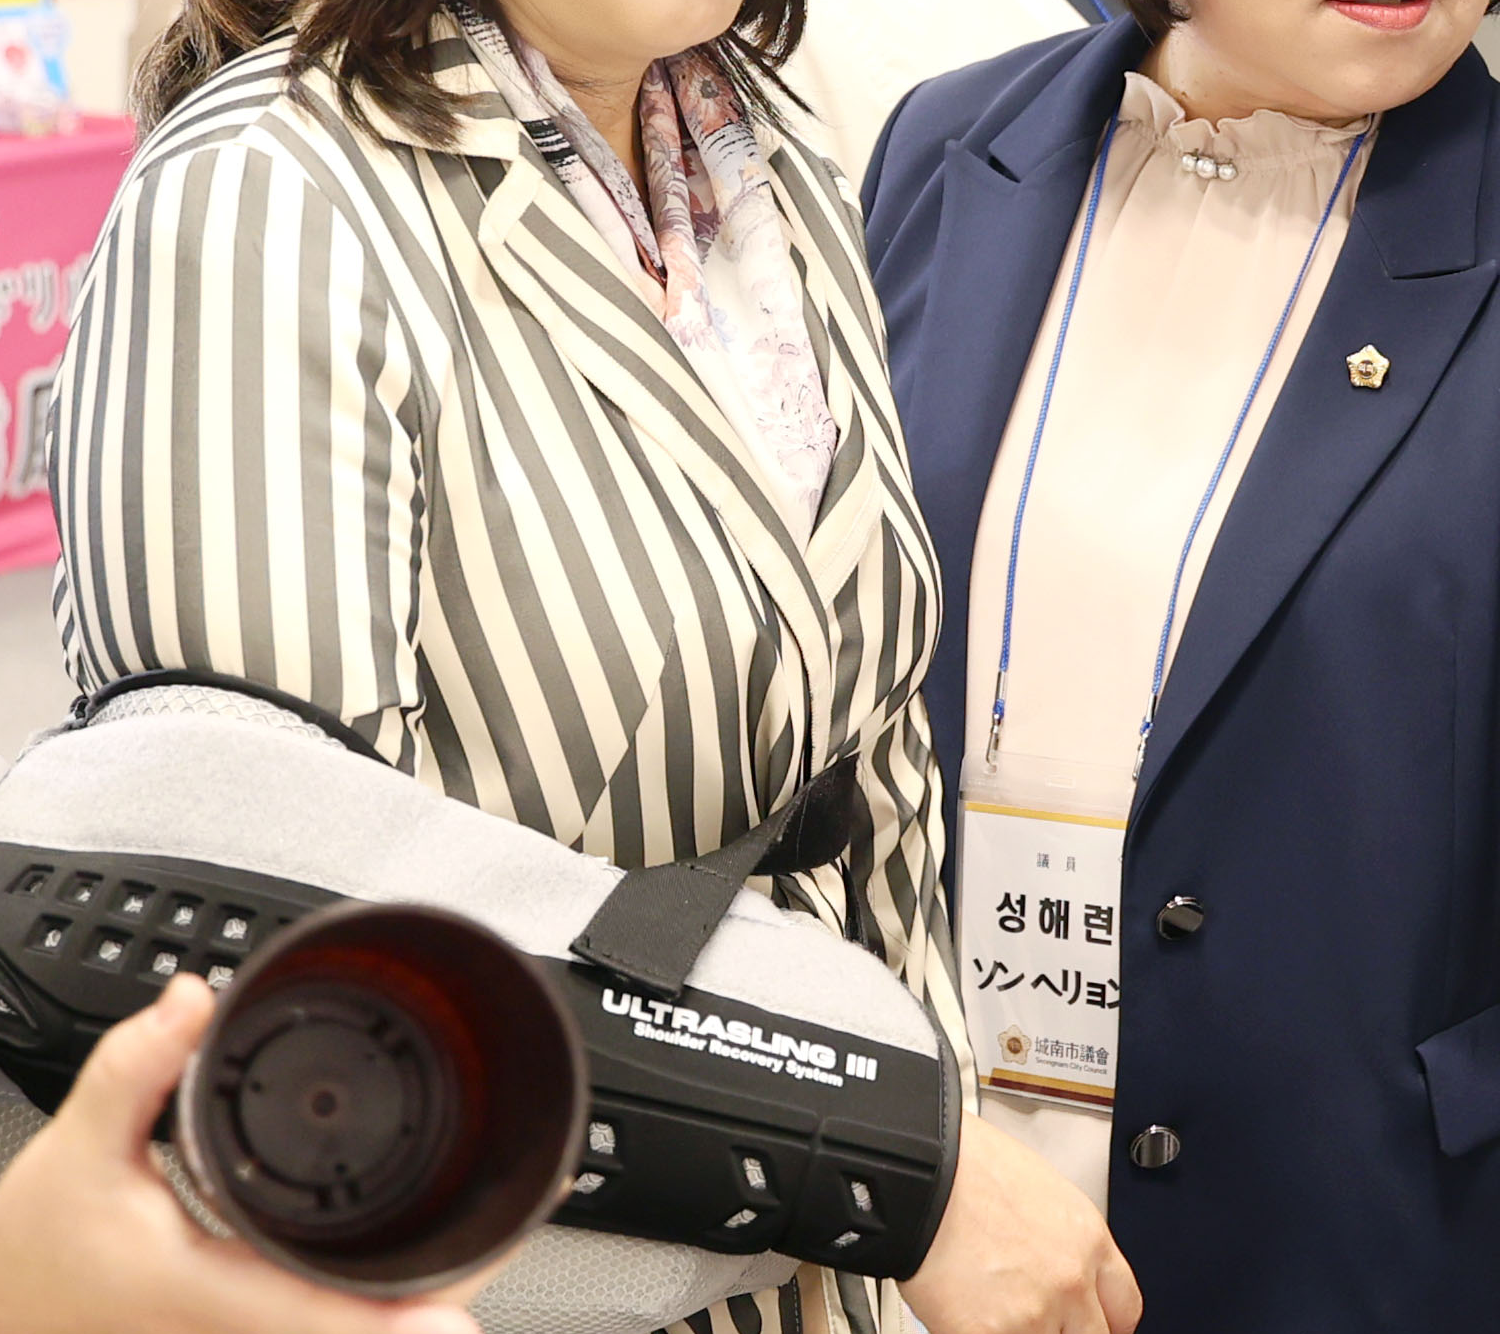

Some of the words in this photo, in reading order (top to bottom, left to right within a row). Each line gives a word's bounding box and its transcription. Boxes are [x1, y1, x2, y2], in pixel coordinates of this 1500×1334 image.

[601, 988, 837, 1069] ULTRASLING
[846, 1053, 878, 1081] III
[634, 1021, 708, 1052] Shoulder
[709, 1038, 785, 1074] Recovery
[785, 1059, 844, 1088] System
